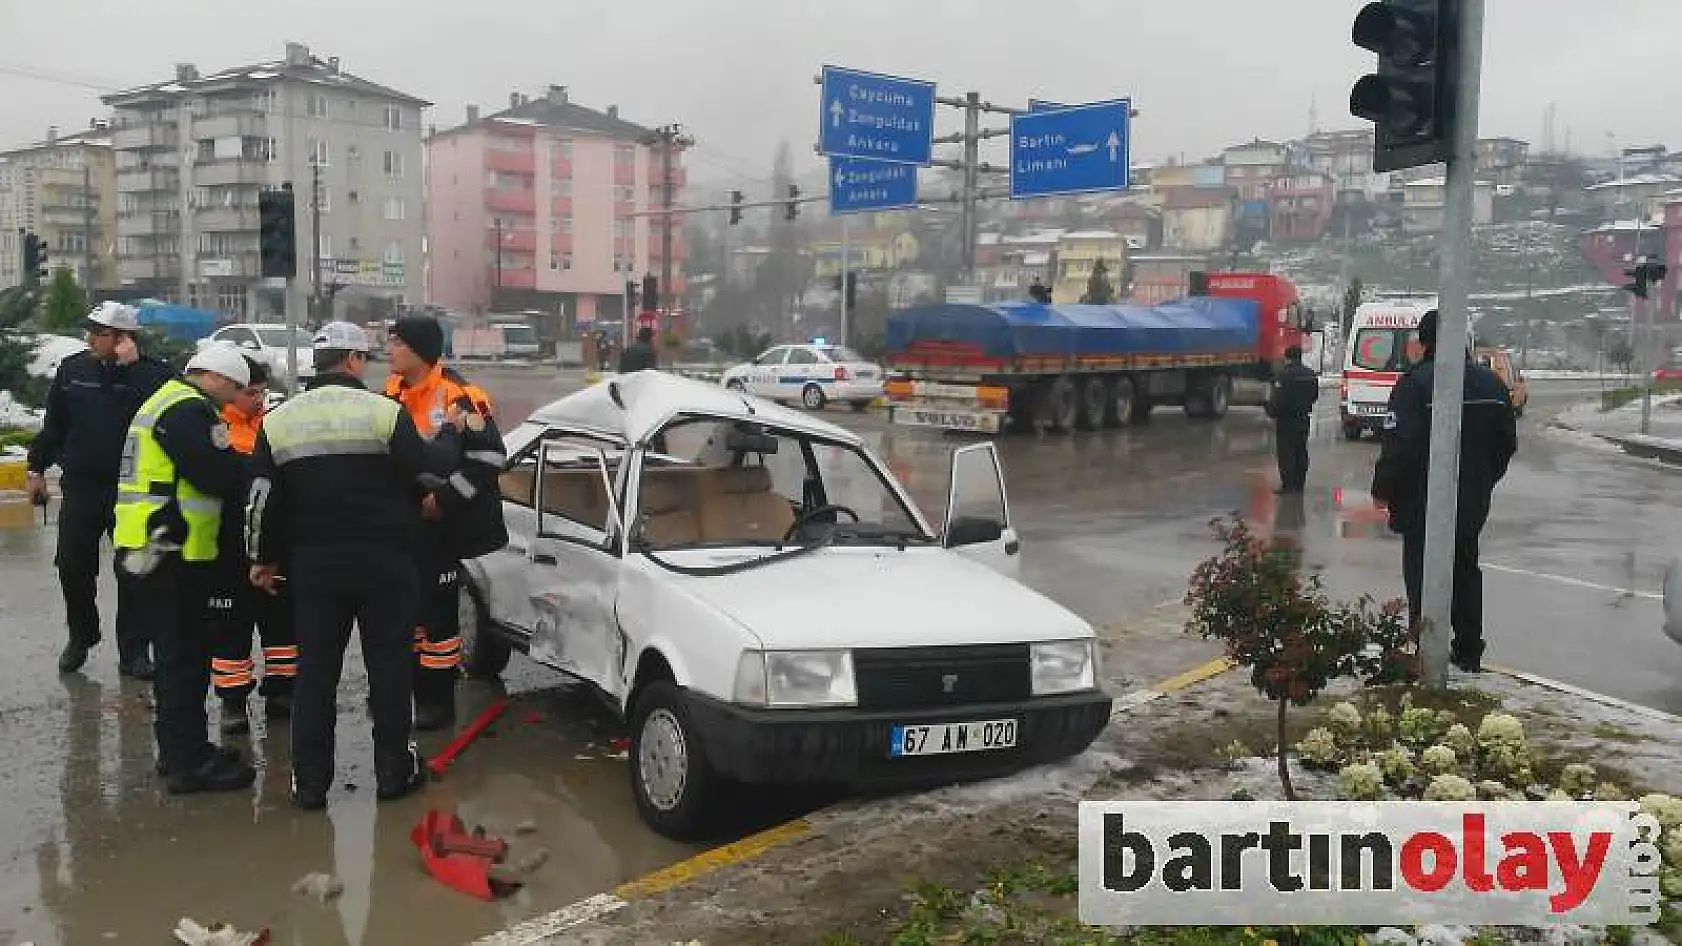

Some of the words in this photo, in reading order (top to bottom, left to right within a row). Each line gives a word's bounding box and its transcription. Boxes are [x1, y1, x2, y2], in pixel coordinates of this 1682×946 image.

[848, 133, 899, 152] Ankara
[905, 727, 930, 753] 67
[942, 725, 968, 750] AN
[983, 722, 1014, 747] 020
